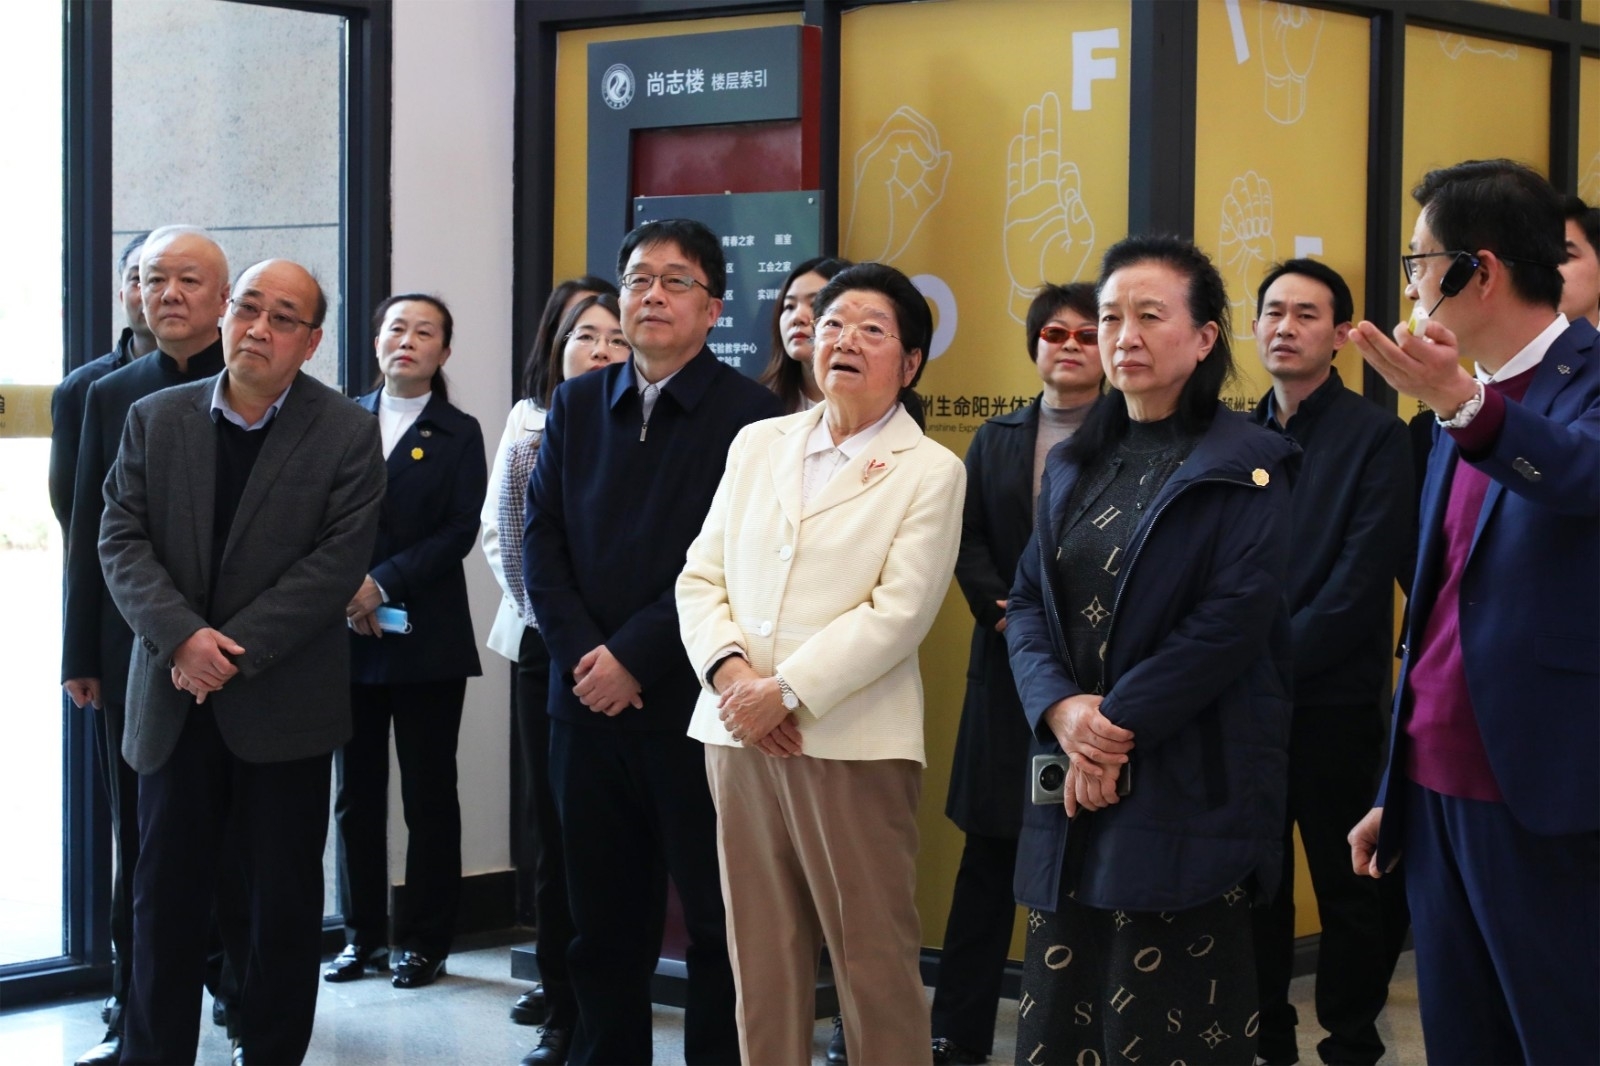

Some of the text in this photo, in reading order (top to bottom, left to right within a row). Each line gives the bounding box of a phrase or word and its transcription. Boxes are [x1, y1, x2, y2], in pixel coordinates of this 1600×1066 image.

[1072, 28, 1119, 111] F
[647, 69, 705, 97] 尚志楼
[711, 69, 768, 92] 楼层索引
[721, 235, 755, 247] 青春之家
[758, 261, 792, 273] 工会之家
[713, 316, 734, 328] 议室
[921, 395, 1036, 418] 州生命阳光体
[924, 422, 956, 433] unshine
